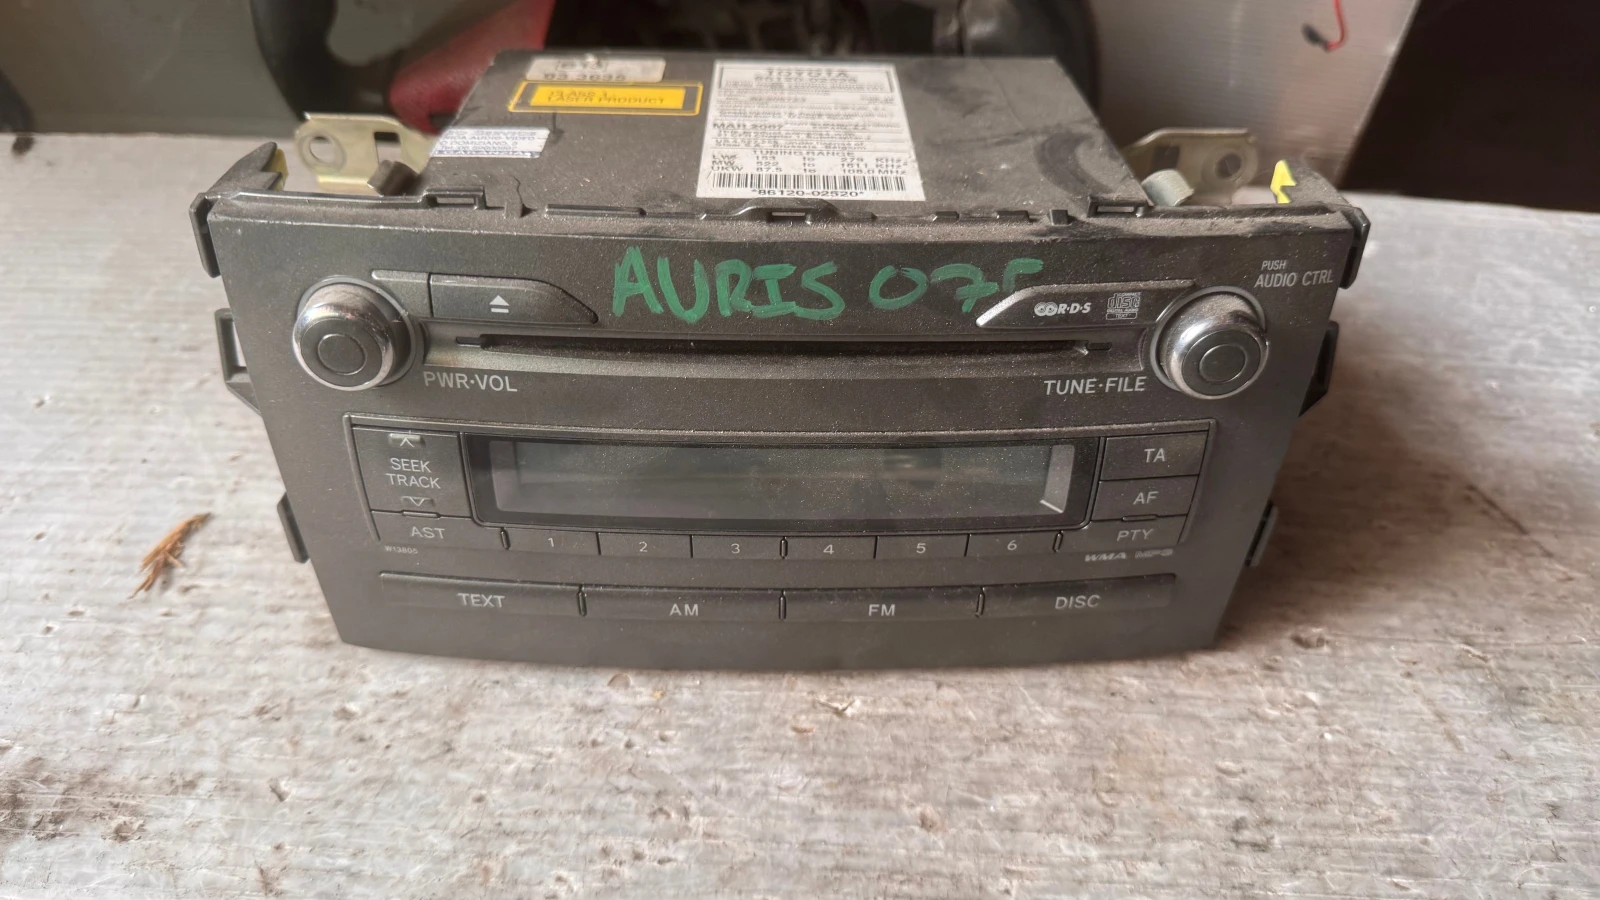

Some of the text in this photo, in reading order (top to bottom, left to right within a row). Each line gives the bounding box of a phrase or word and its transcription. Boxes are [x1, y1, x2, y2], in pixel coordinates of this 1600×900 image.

[595, 97, 665, 105] PRODUCT
[1261, 260, 1287, 271] PUSH
[1254, 269, 1334, 288] AUDIO CTRL
[612, 245, 845, 325] AURIS
[1144, 448, 1166, 463] TA
[390, 457, 431, 473] SEEK
[385, 473, 441, 489] TRACK
[1133, 490, 1159, 505] AF
[411, 526, 445, 540] AST
[1116, 528, 1155, 543] PTY
[548, 537, 555, 548] 1
[638, 541, 648, 553] 2
[916, 543, 926, 554] 5
[1007, 540, 1017, 551] 6
[731, 543, 741, 555] 3
[823, 543, 834, 555] 4
[1084, 552, 1128, 562] WMA
[457, 592, 506, 608] TEXT
[1055, 594, 1102, 610] DISC
[669, 604, 699, 616] AM
[868, 604, 896, 616] FM
